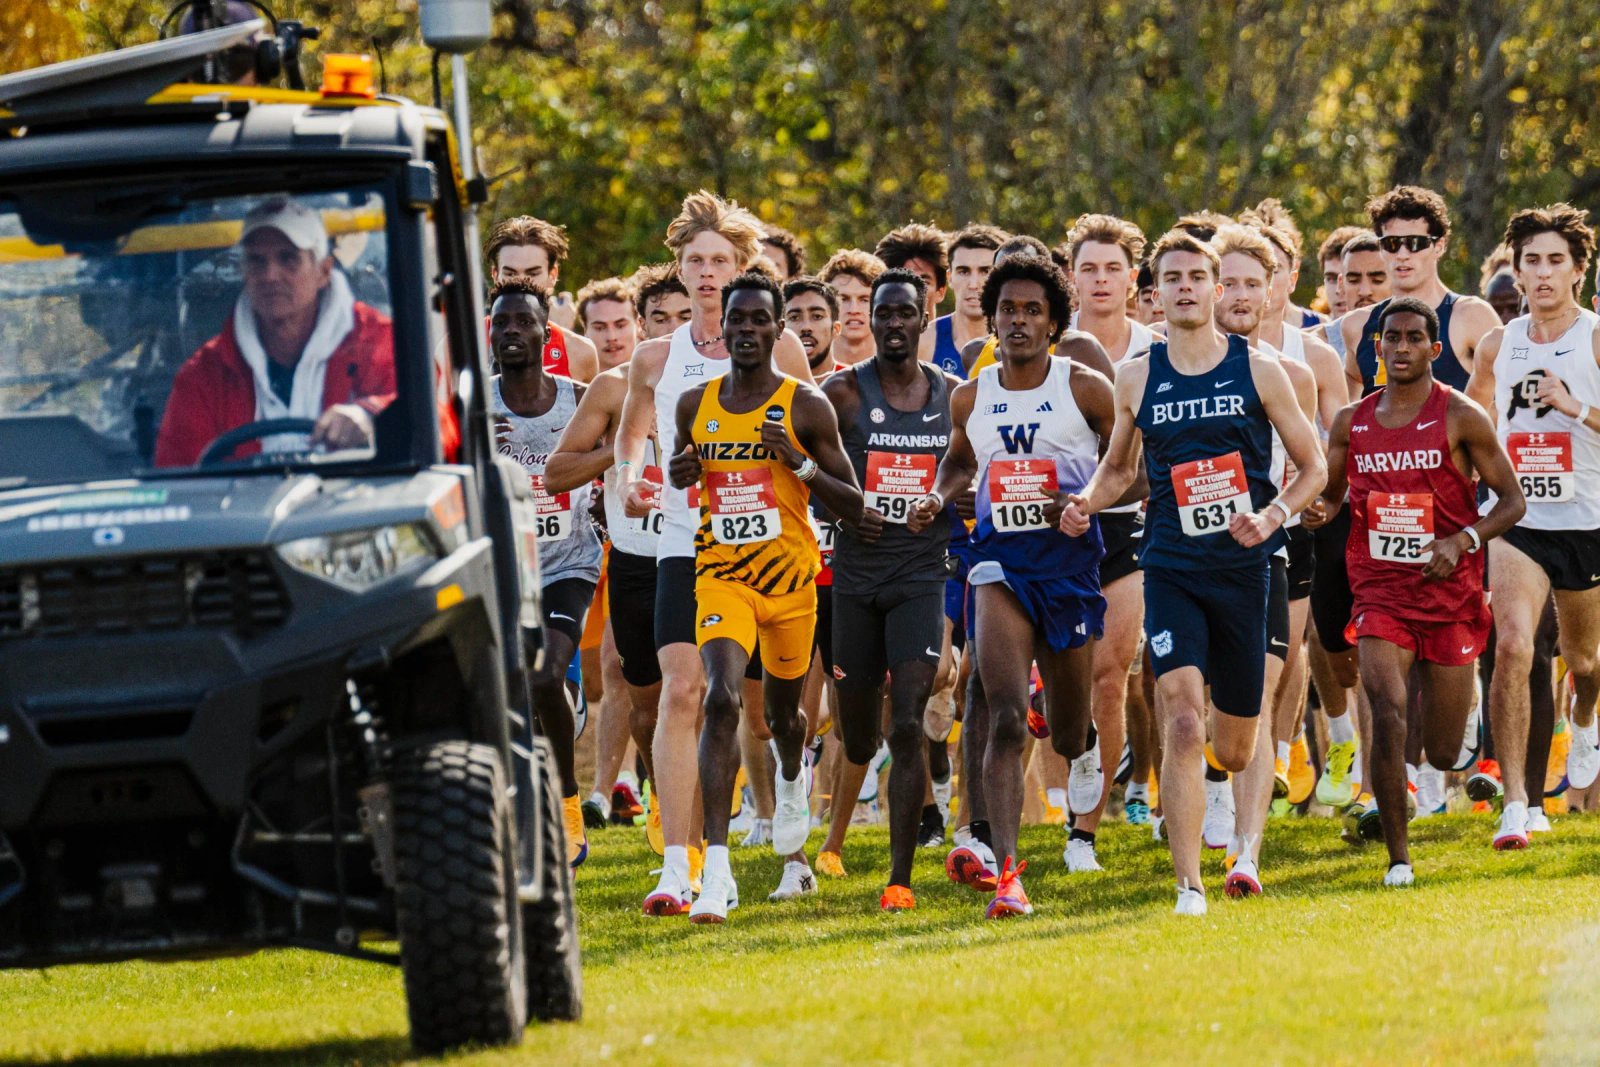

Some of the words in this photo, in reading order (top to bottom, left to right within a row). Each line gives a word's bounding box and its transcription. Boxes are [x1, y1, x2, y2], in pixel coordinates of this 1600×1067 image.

[1152, 395, 1246, 425] BUTLER
[868, 432, 948, 448] ARKANSAS
[997, 423, 1041, 455] W
[1354, 449, 1442, 473] HARVARD
[878, 467, 928, 478] NUTTYCOMBE
[1184, 469, 1236, 487] NUTTYCOMBE
[876, 483, 927, 494] INVITATIONAL
[1187, 485, 1240, 504] INVITATIONAL
[1190, 479, 1231, 495] WISCONSIN
[1519, 476, 1562, 498] 655
[876, 496, 918, 519] 59
[1192, 500, 1237, 530] 631
[721, 514, 768, 540] 823
[1378, 535, 1422, 559] 725
